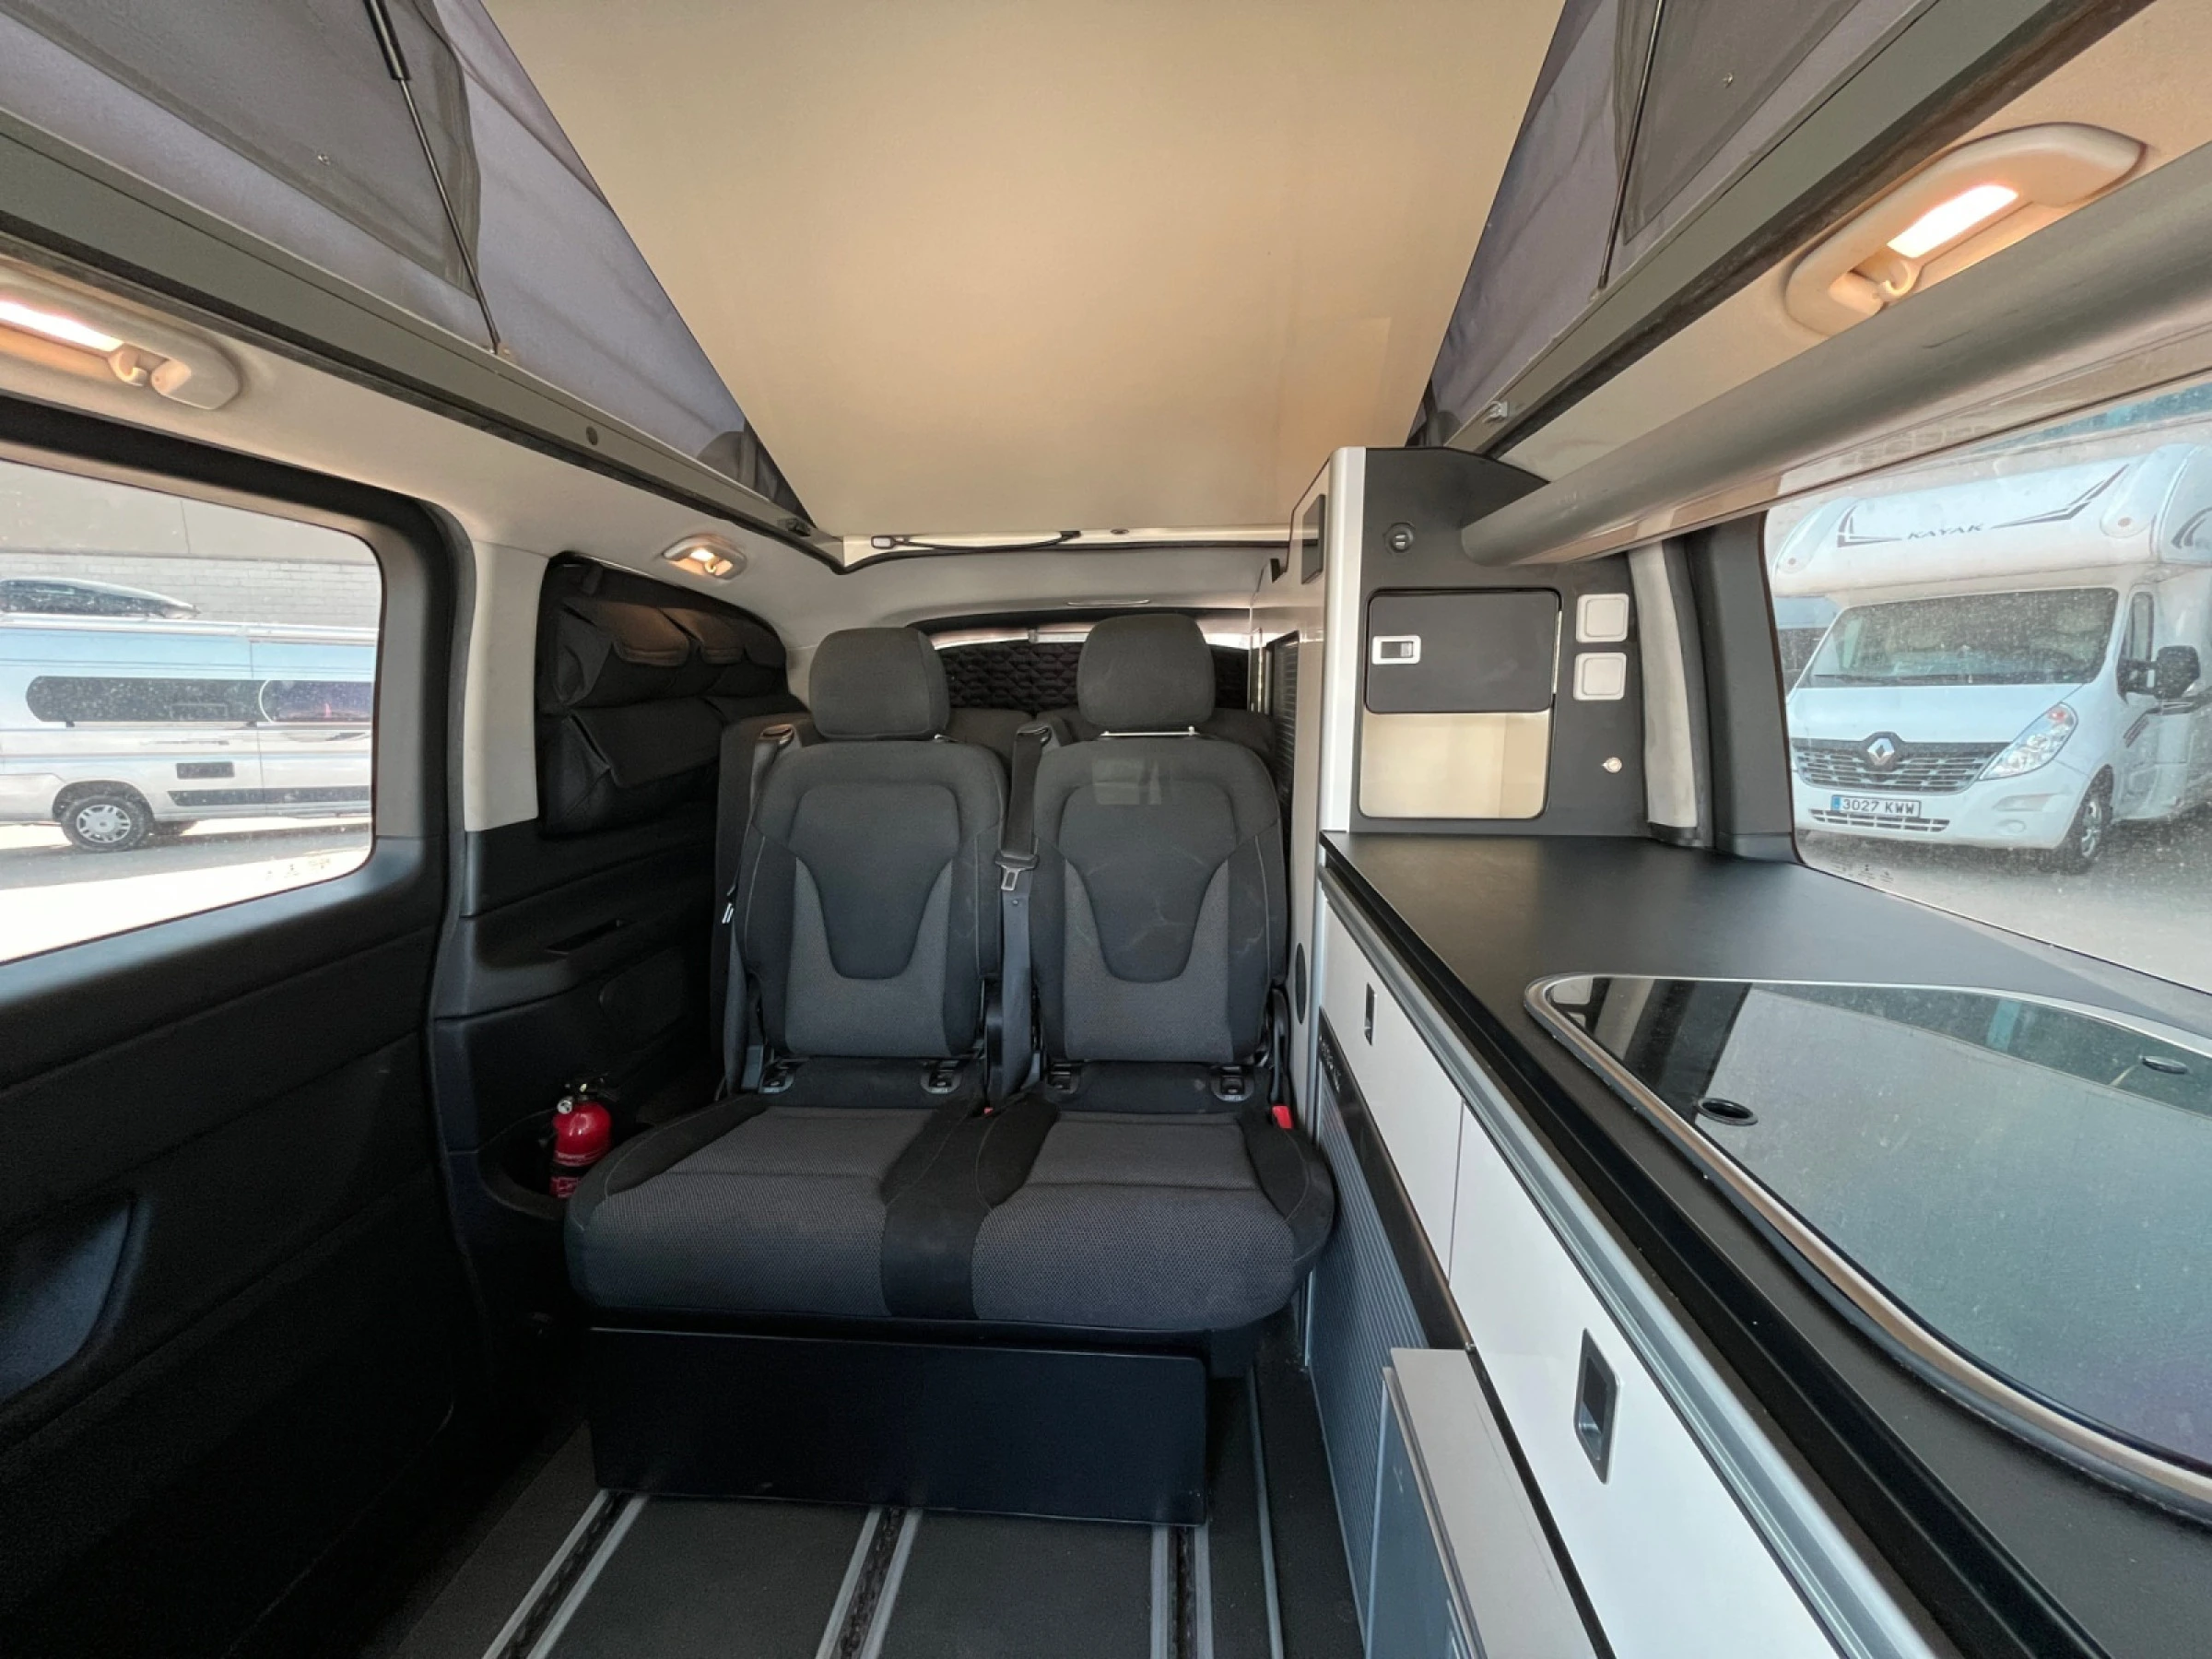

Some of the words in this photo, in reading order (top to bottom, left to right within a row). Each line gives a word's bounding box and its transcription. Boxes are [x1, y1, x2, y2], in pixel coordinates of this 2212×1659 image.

[1907, 524, 1983, 539] KAYAK
[1842, 799, 1879, 812] 3027
[1885, 801, 1914, 814] KWW
